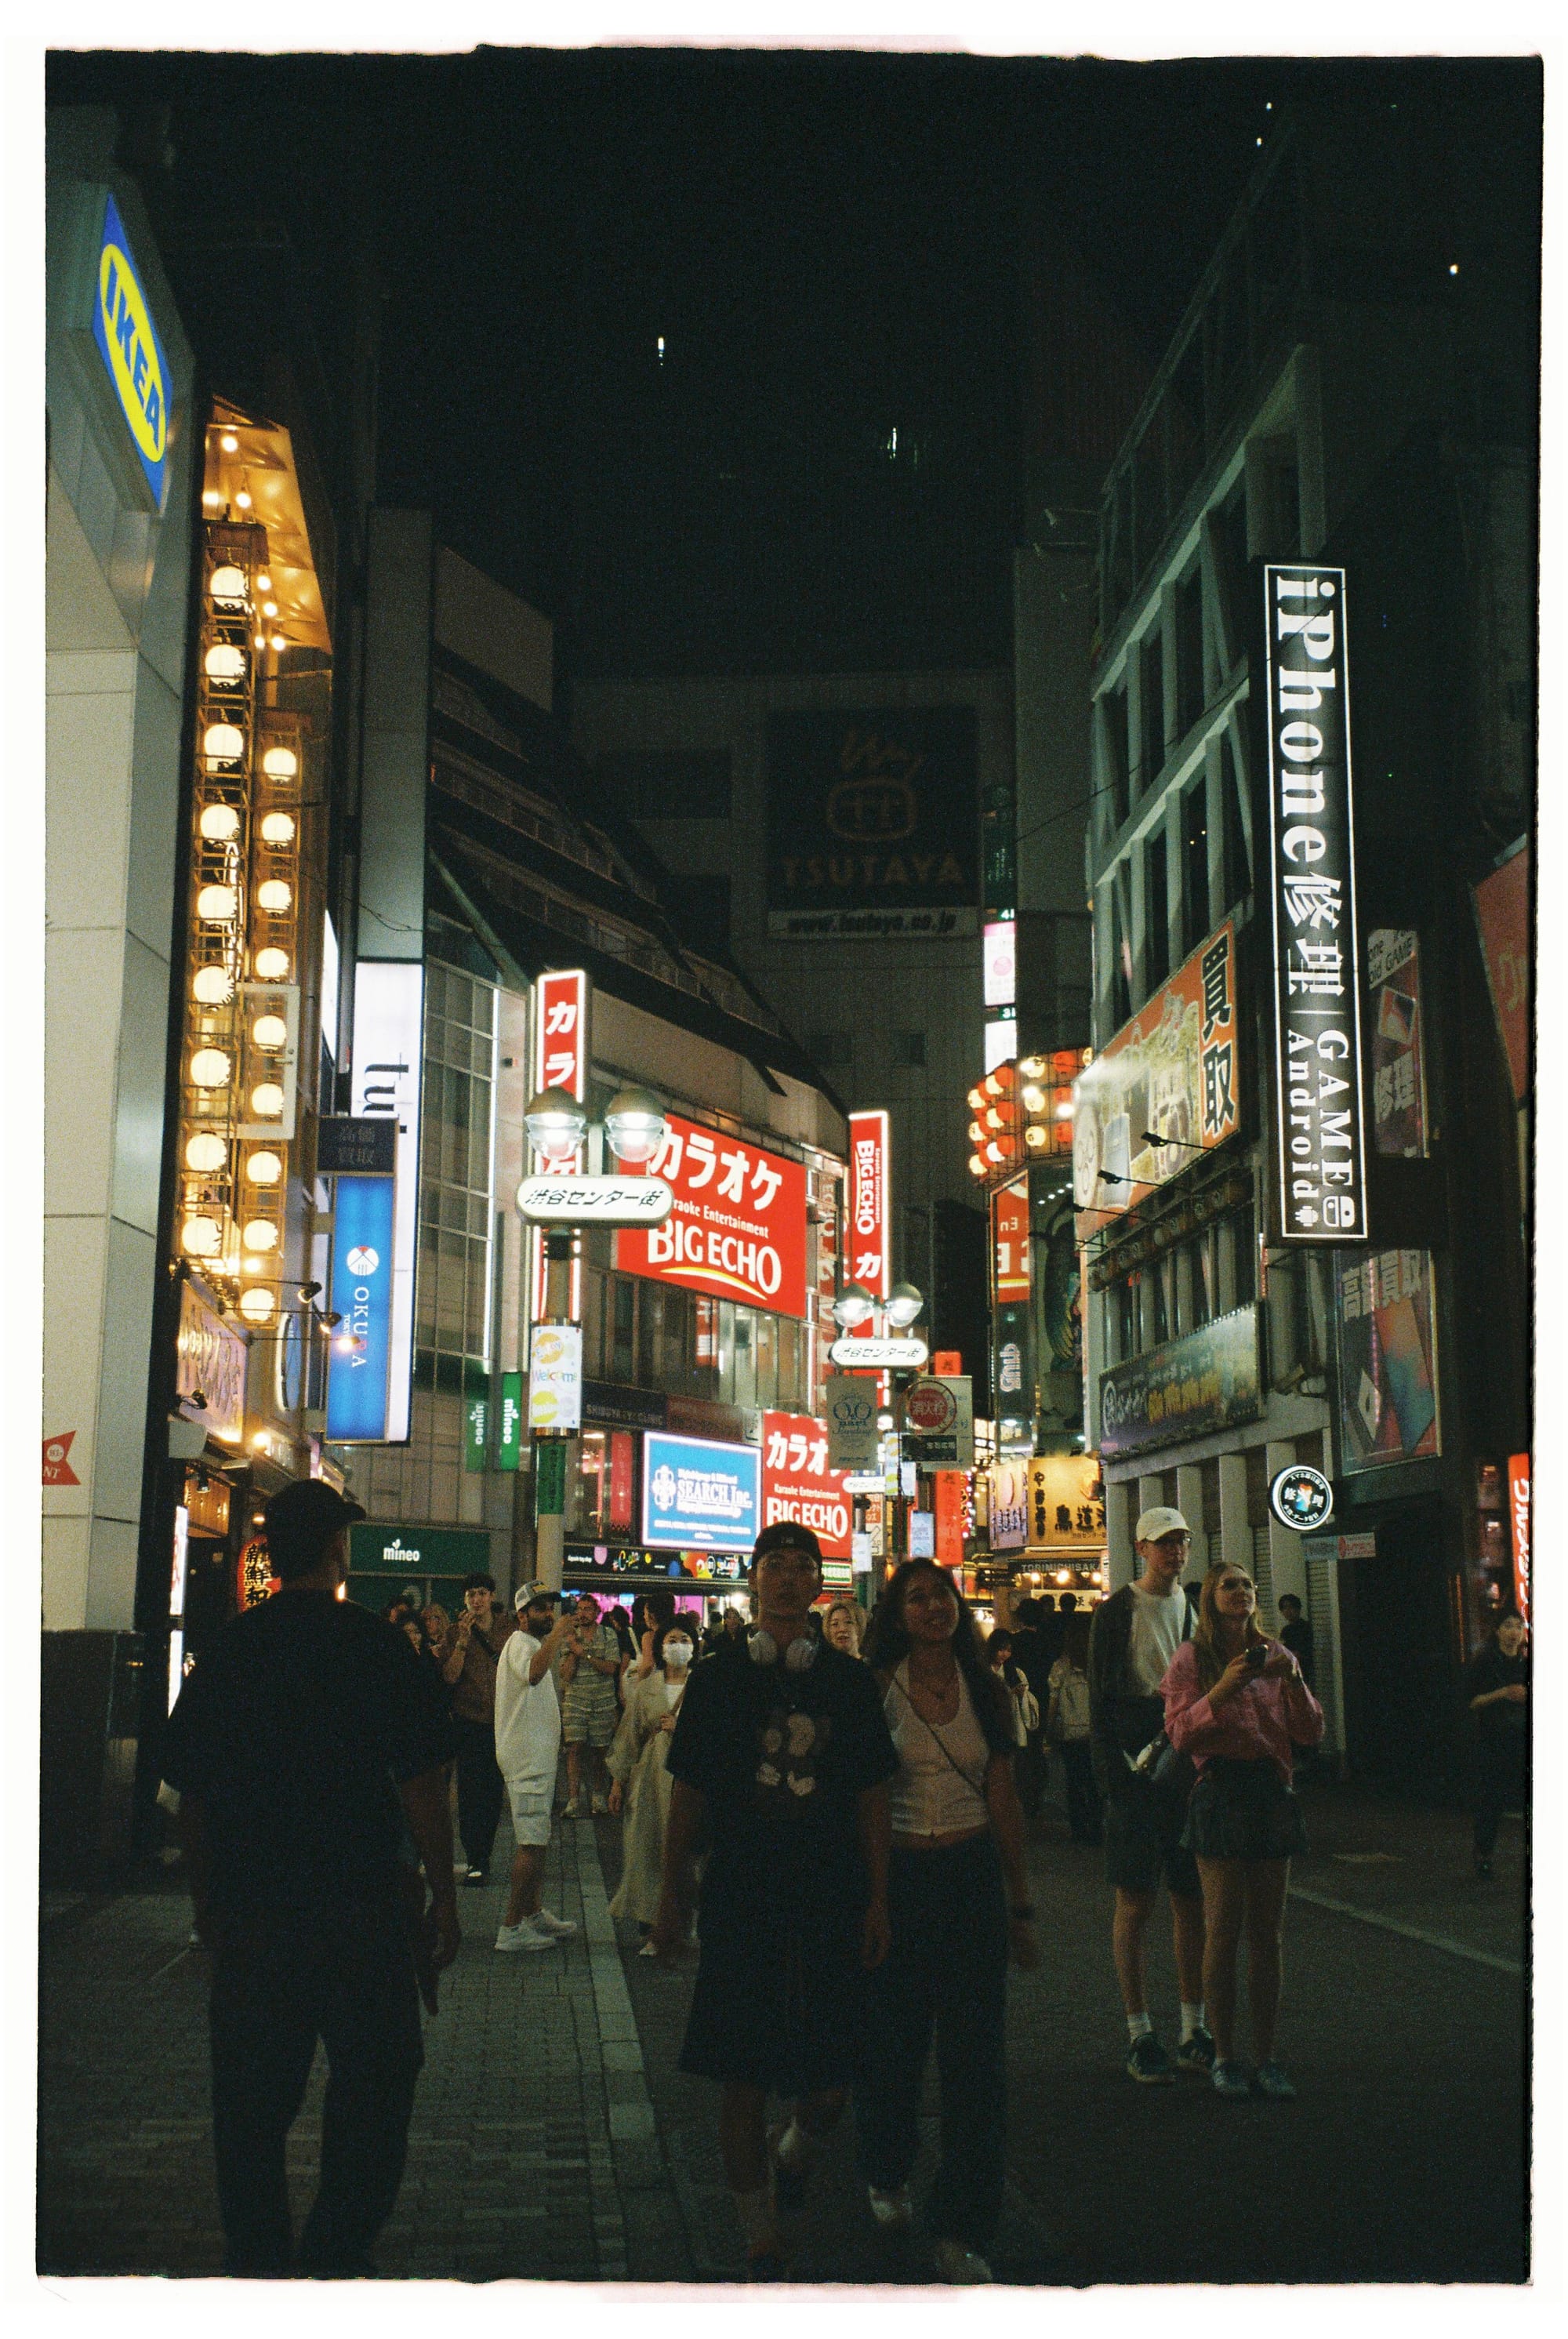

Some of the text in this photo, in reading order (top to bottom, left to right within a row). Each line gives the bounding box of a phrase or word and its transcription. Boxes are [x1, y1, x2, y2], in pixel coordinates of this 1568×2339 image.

[105, 257, 161, 451] IKEA
[1276, 576, 1345, 997] iPhone修理
[782, 853, 965, 888] TSUTAYA
[1201, 931, 1235, 1139] 買取
[1287, 1030, 1319, 1200] Android
[1316, 1030, 1353, 1187] GAME
[646, 1123, 782, 1211] カラオケ
[856, 1139, 875, 1235] BIG ECHO
[524, 1187, 663, 1209] 渋谷センター街
[671, 1197, 769, 1240] raoke Entertainment
[648, 1219, 782, 1295] BIG ECHO
[351, 1286, 370, 1367] OKURA
[837, 1346, 920, 1360] 渋谷センター街
[503, 1399, 519, 1444] mineo
[766, 1431, 840, 1477] カラオ
[677, 1480, 728, 1504] SEARCH
[800, 1486, 840, 1502] Entertainment
[766, 1497, 800, 1527] BIG
[801, 1503, 848, 1538] ECHO
[383, 1538, 420, 1563] mineo
